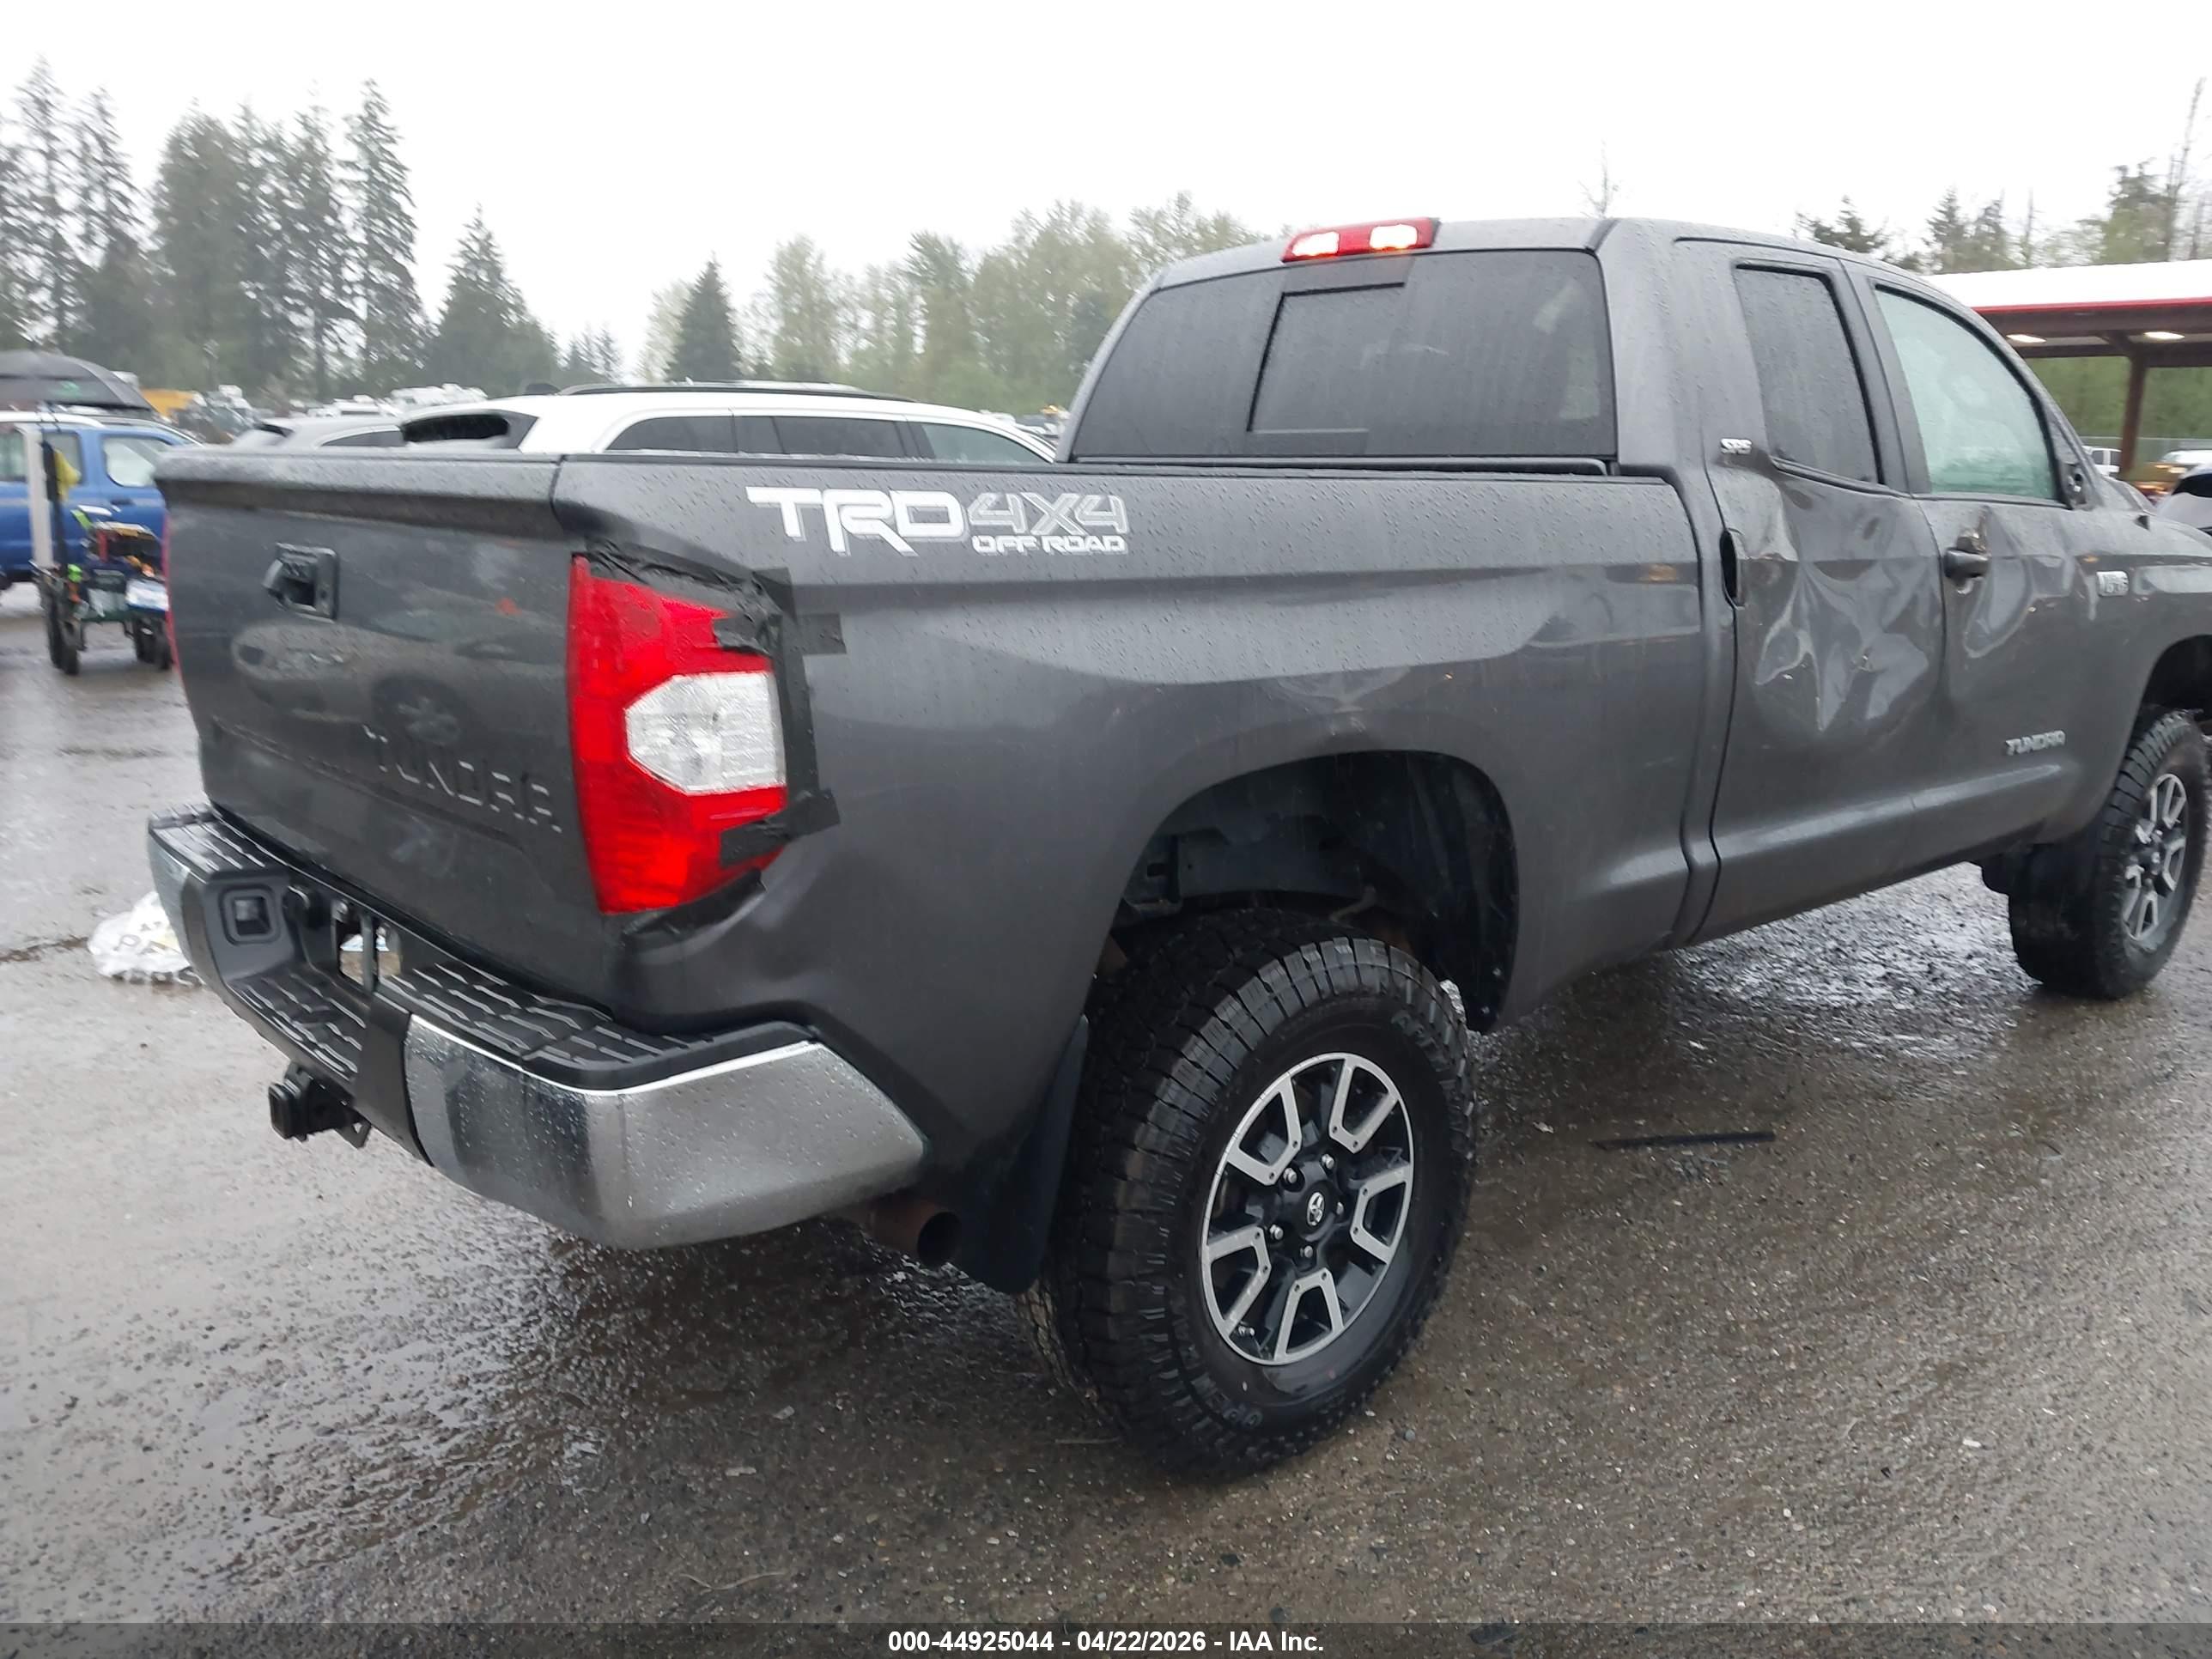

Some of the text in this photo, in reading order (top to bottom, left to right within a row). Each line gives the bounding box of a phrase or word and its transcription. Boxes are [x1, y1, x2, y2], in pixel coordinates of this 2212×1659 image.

[745, 486, 967, 556] TRD
[971, 535, 1128, 555] OFF ROAD
